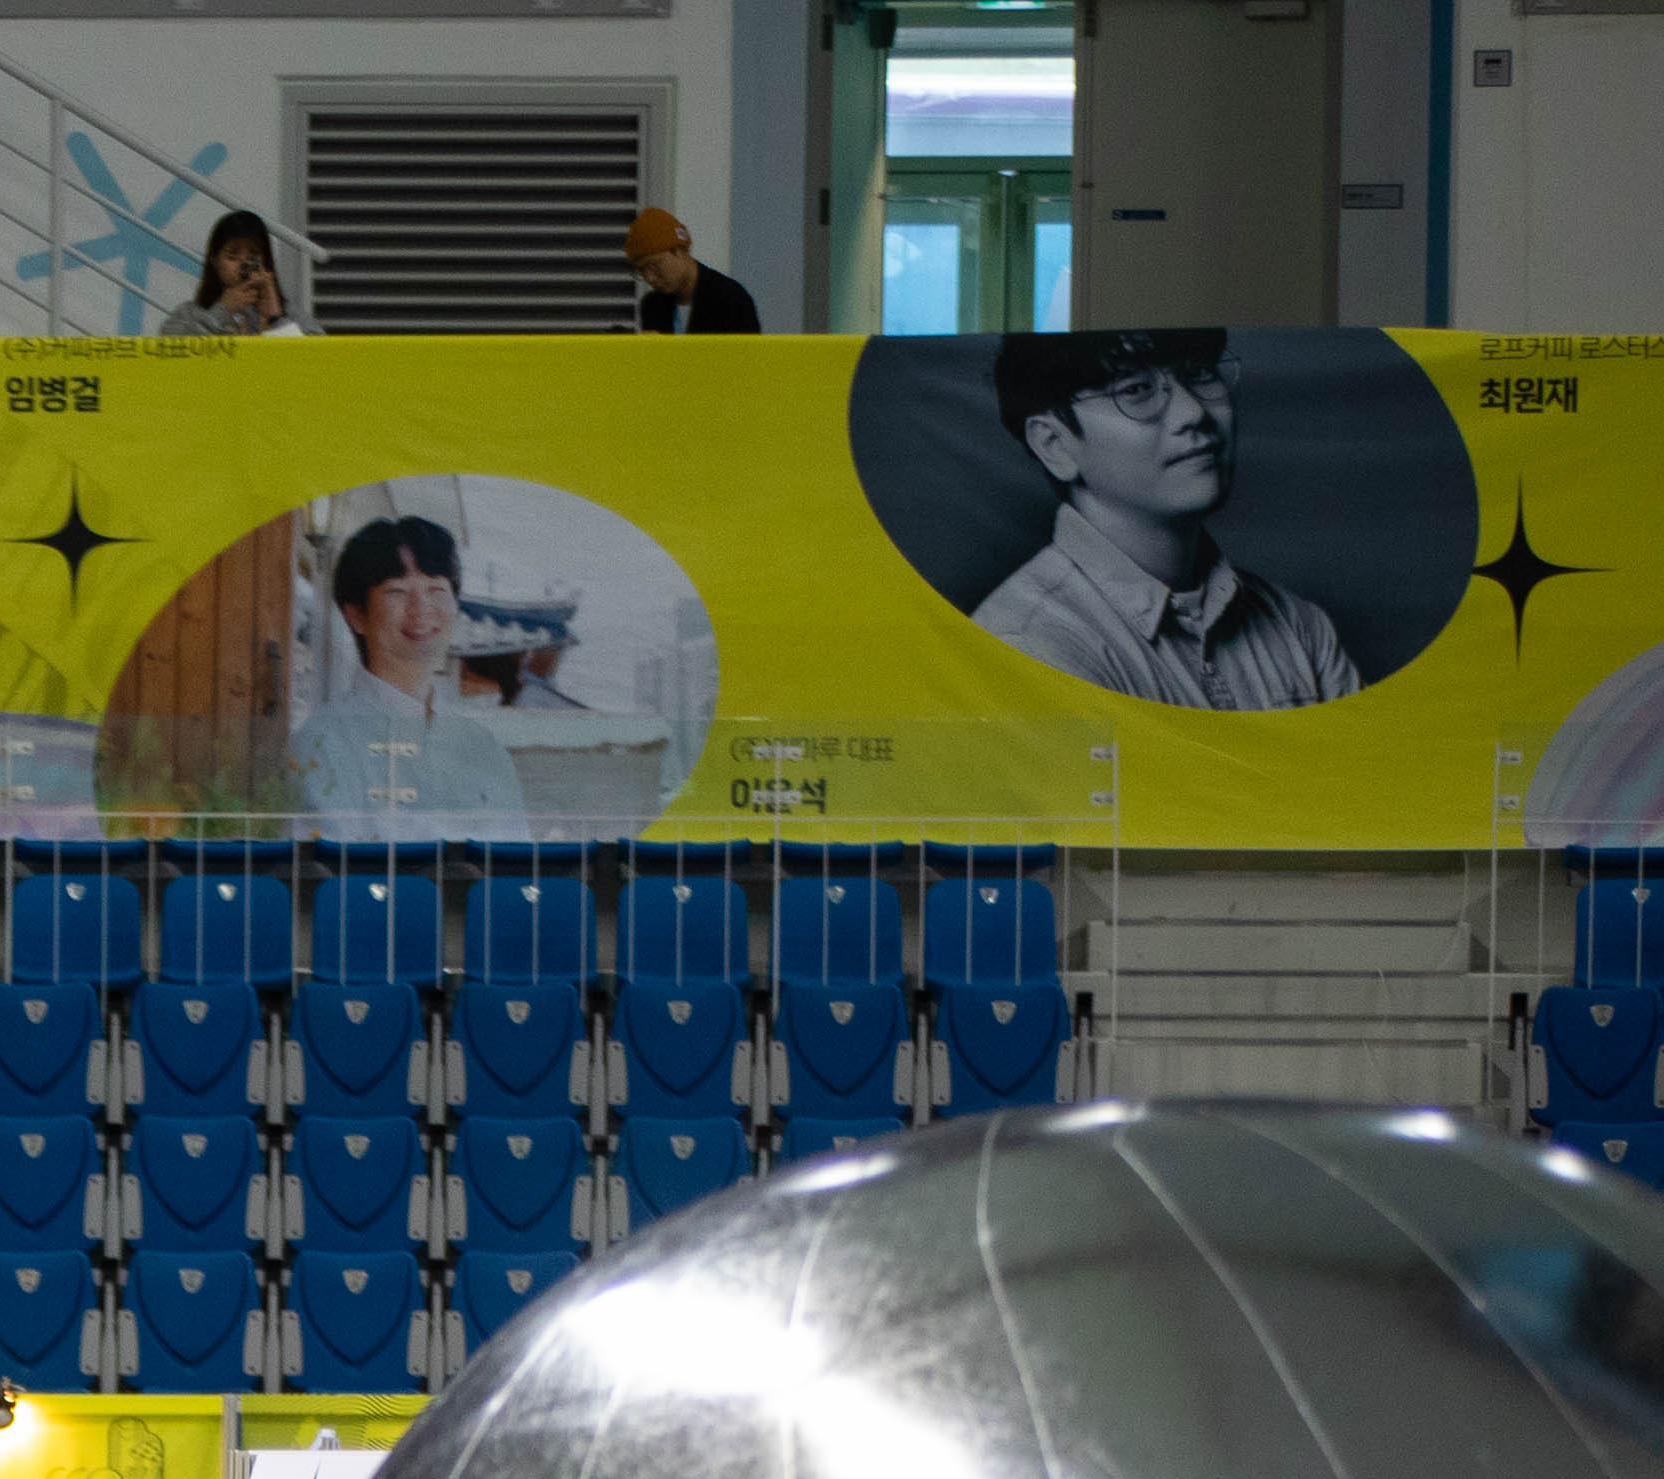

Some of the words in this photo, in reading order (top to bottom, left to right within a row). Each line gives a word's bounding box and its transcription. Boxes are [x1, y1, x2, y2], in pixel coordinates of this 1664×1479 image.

[1479, 336, 1573, 361] 로프커피
[4, 375, 103, 414] 임병걸
[1479, 376, 1579, 415] 최원재
